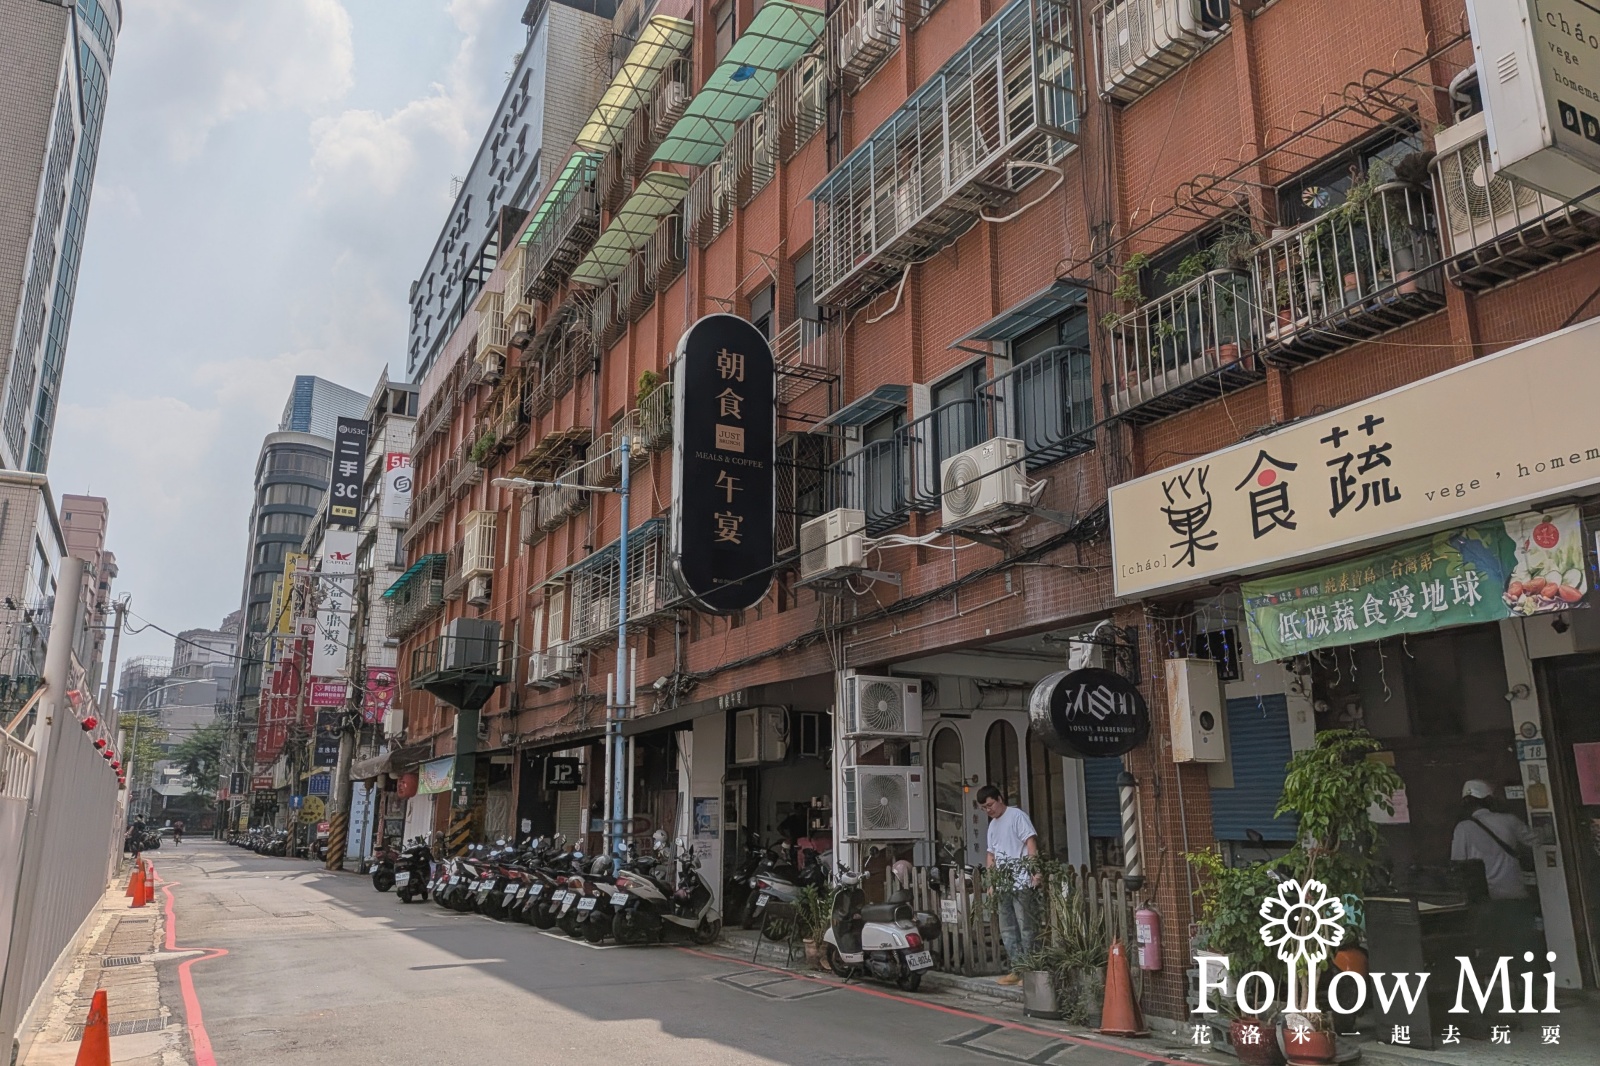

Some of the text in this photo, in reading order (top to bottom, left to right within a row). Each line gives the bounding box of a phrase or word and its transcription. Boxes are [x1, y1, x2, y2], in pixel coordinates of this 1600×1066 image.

[1548, 42, 1580, 66] vege
[715, 348, 745, 420] 朝食
[718, 430, 741, 440] JUST
[718, 438, 741, 447] BRUNCH
[390, 455, 410, 468] 5F
[695, 451, 724, 463] MEALS
[731, 457, 764, 469] COFFEE
[1425, 479, 1481, 501] vege
[714, 469, 744, 545] 午宴
[1121, 554, 1168, 579] [cháo]
[1277, 570, 1482, 643] 低碳蔬食愛地球
[1528, 746, 1542, 758] 18
